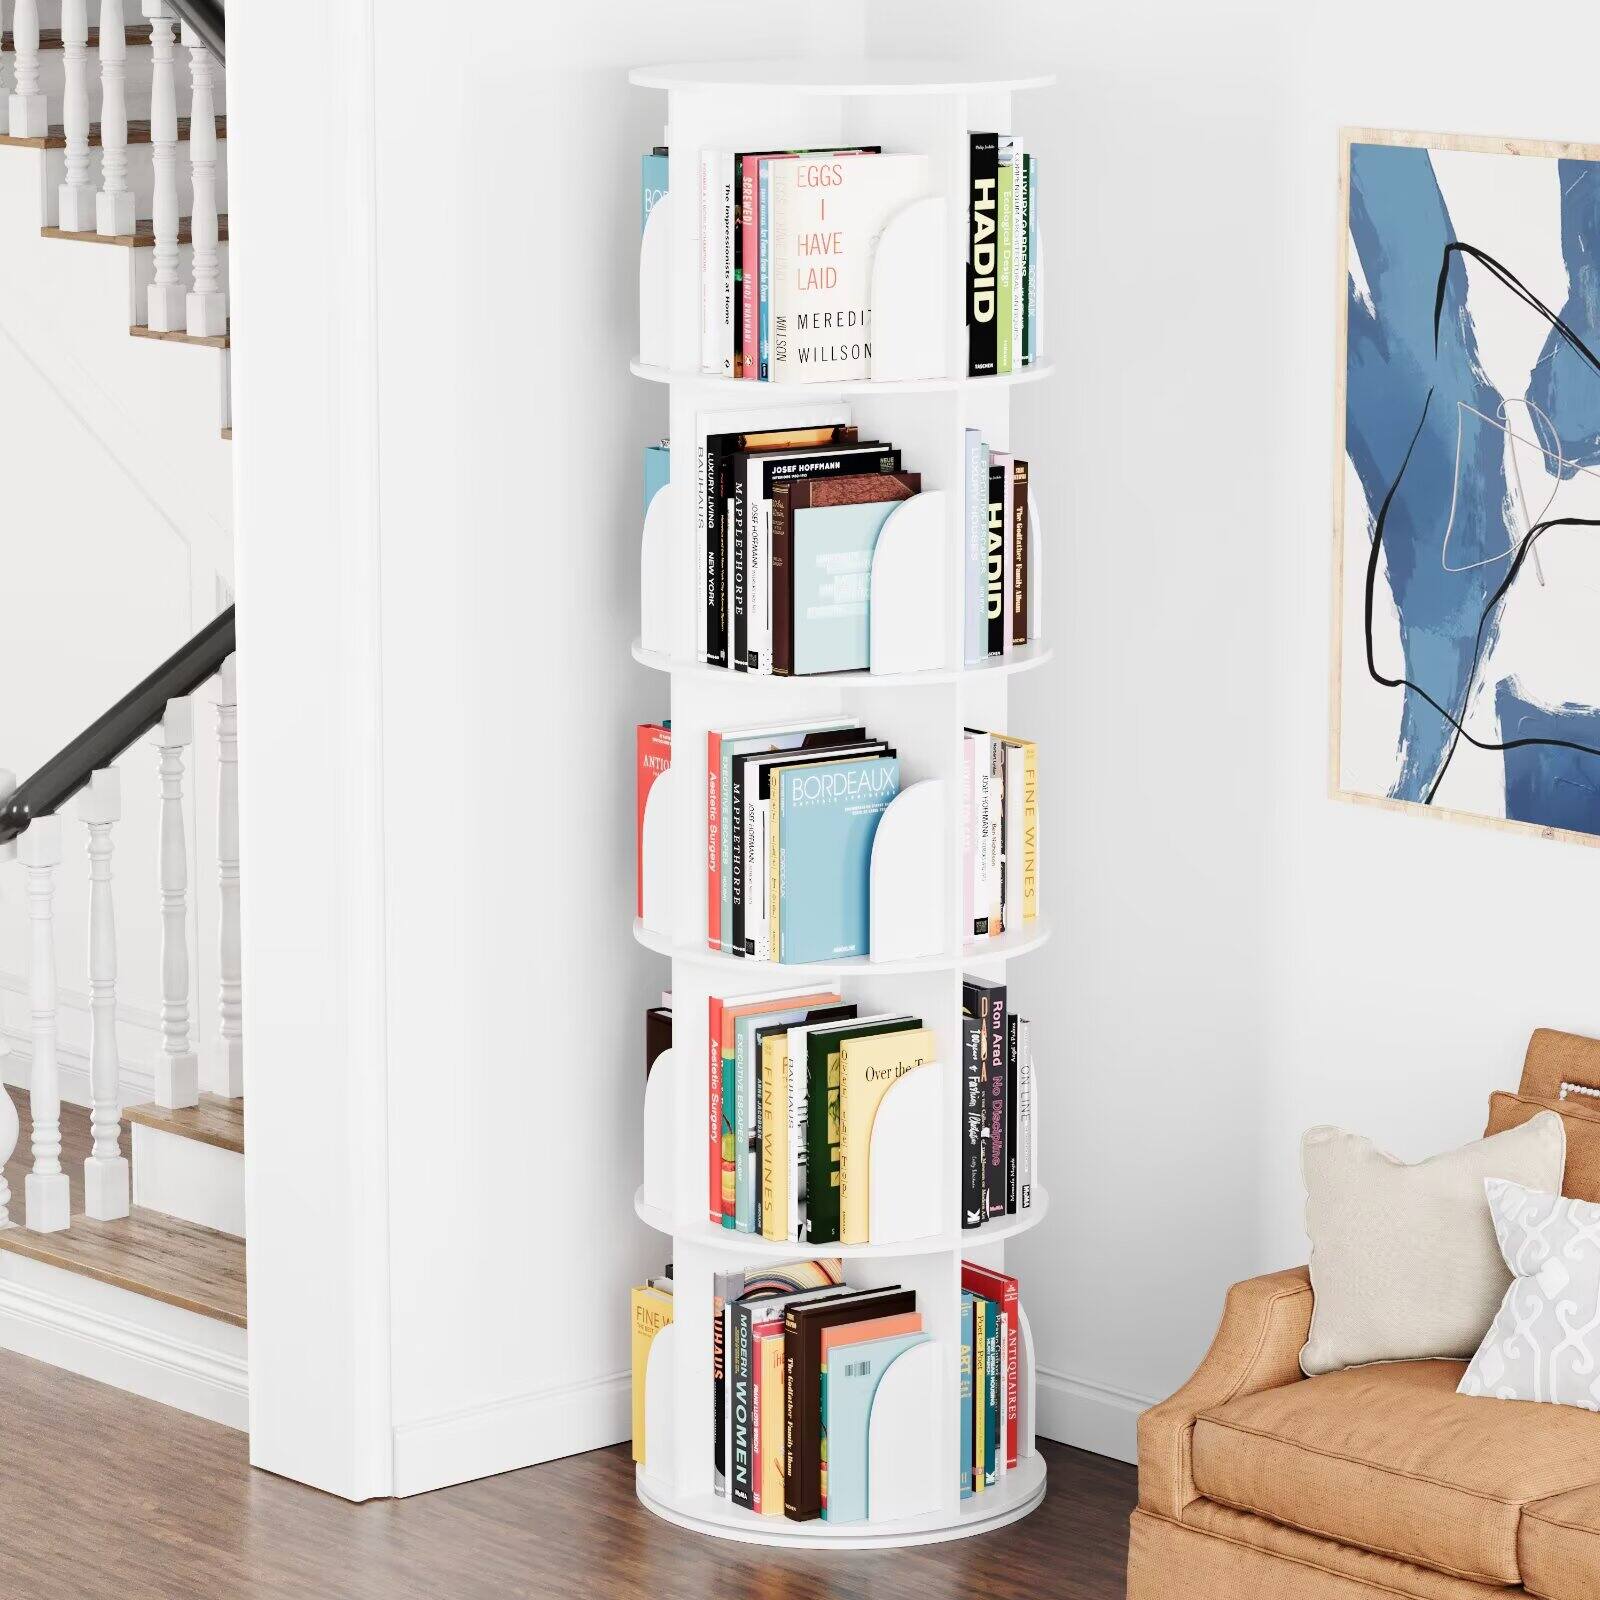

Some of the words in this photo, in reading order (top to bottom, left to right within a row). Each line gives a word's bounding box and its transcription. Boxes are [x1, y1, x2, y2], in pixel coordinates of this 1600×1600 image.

[723, 184, 731, 202] The
[797, 164, 843, 188] EGGS
[743, 176, 753, 225] SCREWED!
[821, 198, 825, 221] I
[1001, 191, 1012, 246] Ecological
[723, 205, 731, 279] Impressionists
[797, 232, 843, 257] HAVE
[973, 178, 995, 323] HADID
[798, 267, 837, 291] LAID
[1001, 250, 1012, 288] Design
[723, 282, 731, 292] at
[723, 296, 731, 325] Home
[776, 316, 787, 362] WILLSON
[707, 452, 715, 494] LUXURY
[771, 465, 797, 474] JOSEF
[799, 462, 841, 472] HOFFMANN
[707, 495, 715, 529] LIVING
[751, 502, 759, 524] JOSEF
[1015, 506, 1023, 522] The
[735, 481, 743, 616] MAPPLETHORPE
[751, 525, 759, 569] HOFFMANN
[1015, 523, 1023, 561] Godfather
[988, 502, 1002, 620] HADID
[1015, 563, 1023, 588] Family
[1015, 590, 1023, 613] Album
[708, 771, 717, 821] Aestetic
[792, 767, 895, 801] BORDEAUX
[1025, 769, 1035, 817] FINE
[708, 824, 717, 873] Surgery
[733, 782, 741, 905] MAPPLETHORPE
[1025, 826, 1035, 898] WINES
[991, 1000, 1003, 1031] Ron
[709, 1039, 719, 1090] Aestetic
[991, 1034, 1003, 1067] Arad
[865, 1065, 892, 1082] Over
[990, 1076, 1003, 1096] No
[1020, 1065, 1030, 1085] ON
[764, 1066, 773, 1121] FINE
[967, 1076, 980, 1107] Fashion
[1020, 1092, 1030, 1122] LINE
[709, 1093, 719, 1143] Surgery
[990, 1100, 1003, 1166] Discipline
[764, 1133, 773, 1214] WINES
[1022, 1186, 1030, 1208] MoMA
[636, 1305, 660, 1329] FINE
[740, 1313, 748, 1378] MODERN
[786, 1357, 794, 1374] The
[1008, 1328, 1017, 1420] ANTIQUAIRES
[786, 1375, 794, 1419] Godfather
[736, 1380, 747, 1484] WOMEN
[786, 1420, 794, 1448] Family
[786, 1449, 794, 1477] Album
